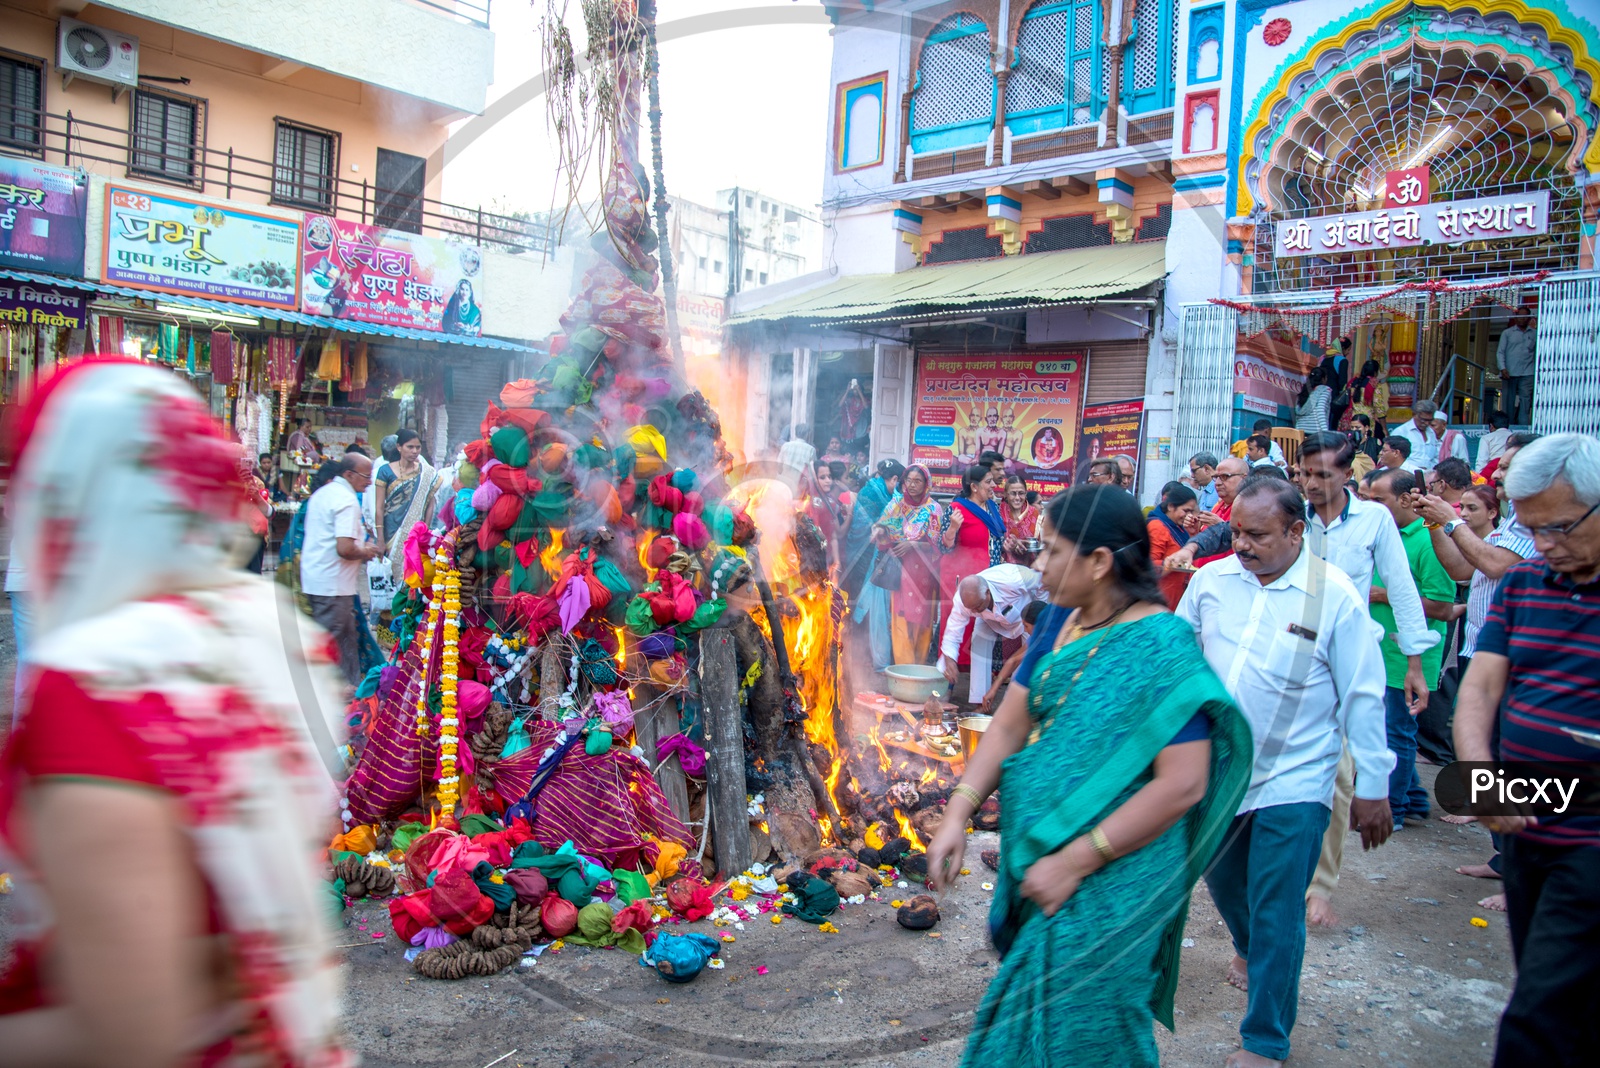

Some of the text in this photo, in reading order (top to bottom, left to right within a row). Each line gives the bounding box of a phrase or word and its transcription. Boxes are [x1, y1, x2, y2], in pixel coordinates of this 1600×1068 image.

[121, 53, 131, 61] LG
[1282, 201, 1538, 250] श्री अंबादेवी संस्थान
[115, 211, 228, 266] प्रभू
[117, 249, 213, 276] पुष्प भंडार
[336, 232, 415, 277] स्नेहा
[18, 285, 80, 309] मिळेल
[225, 286, 240, 296] पूजा
[361, 273, 445, 304] पुष्प भंडार
[31, 308, 80, 329] मिळेल
[925, 360, 936, 371] श्री
[965, 361, 997, 371] गजानन
[1001, 360, 1034, 371] महाराज
[1039, 362, 1057, 373] १४०
[925, 373, 1071, 393] प्रगटदिन महोत्सव
